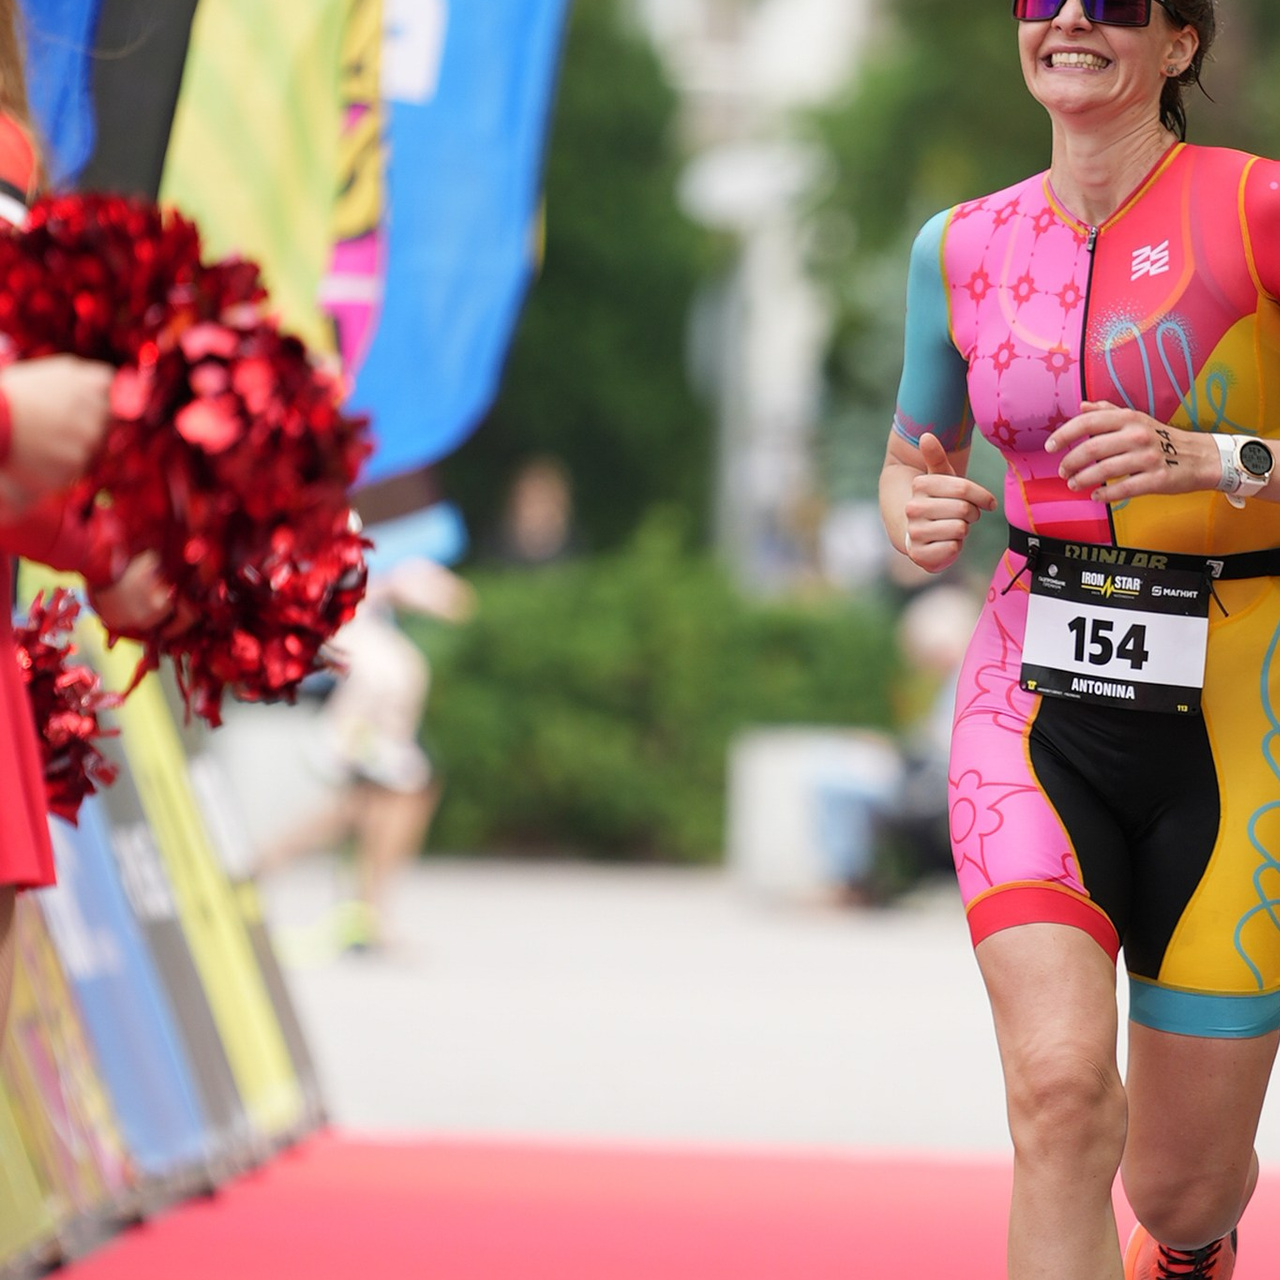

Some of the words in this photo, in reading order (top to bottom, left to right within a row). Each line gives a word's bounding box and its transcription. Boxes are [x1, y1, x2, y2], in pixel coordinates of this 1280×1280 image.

[1155, 429, 1179, 467] 154
[1081, 571, 1105, 587] IRON
[1114, 575, 1140, 591] STAR
[1163, 588, 1198, 599] МАГНИТ
[1068, 616, 1149, 670] 154
[1071, 678, 1136, 700] ANTONINA
